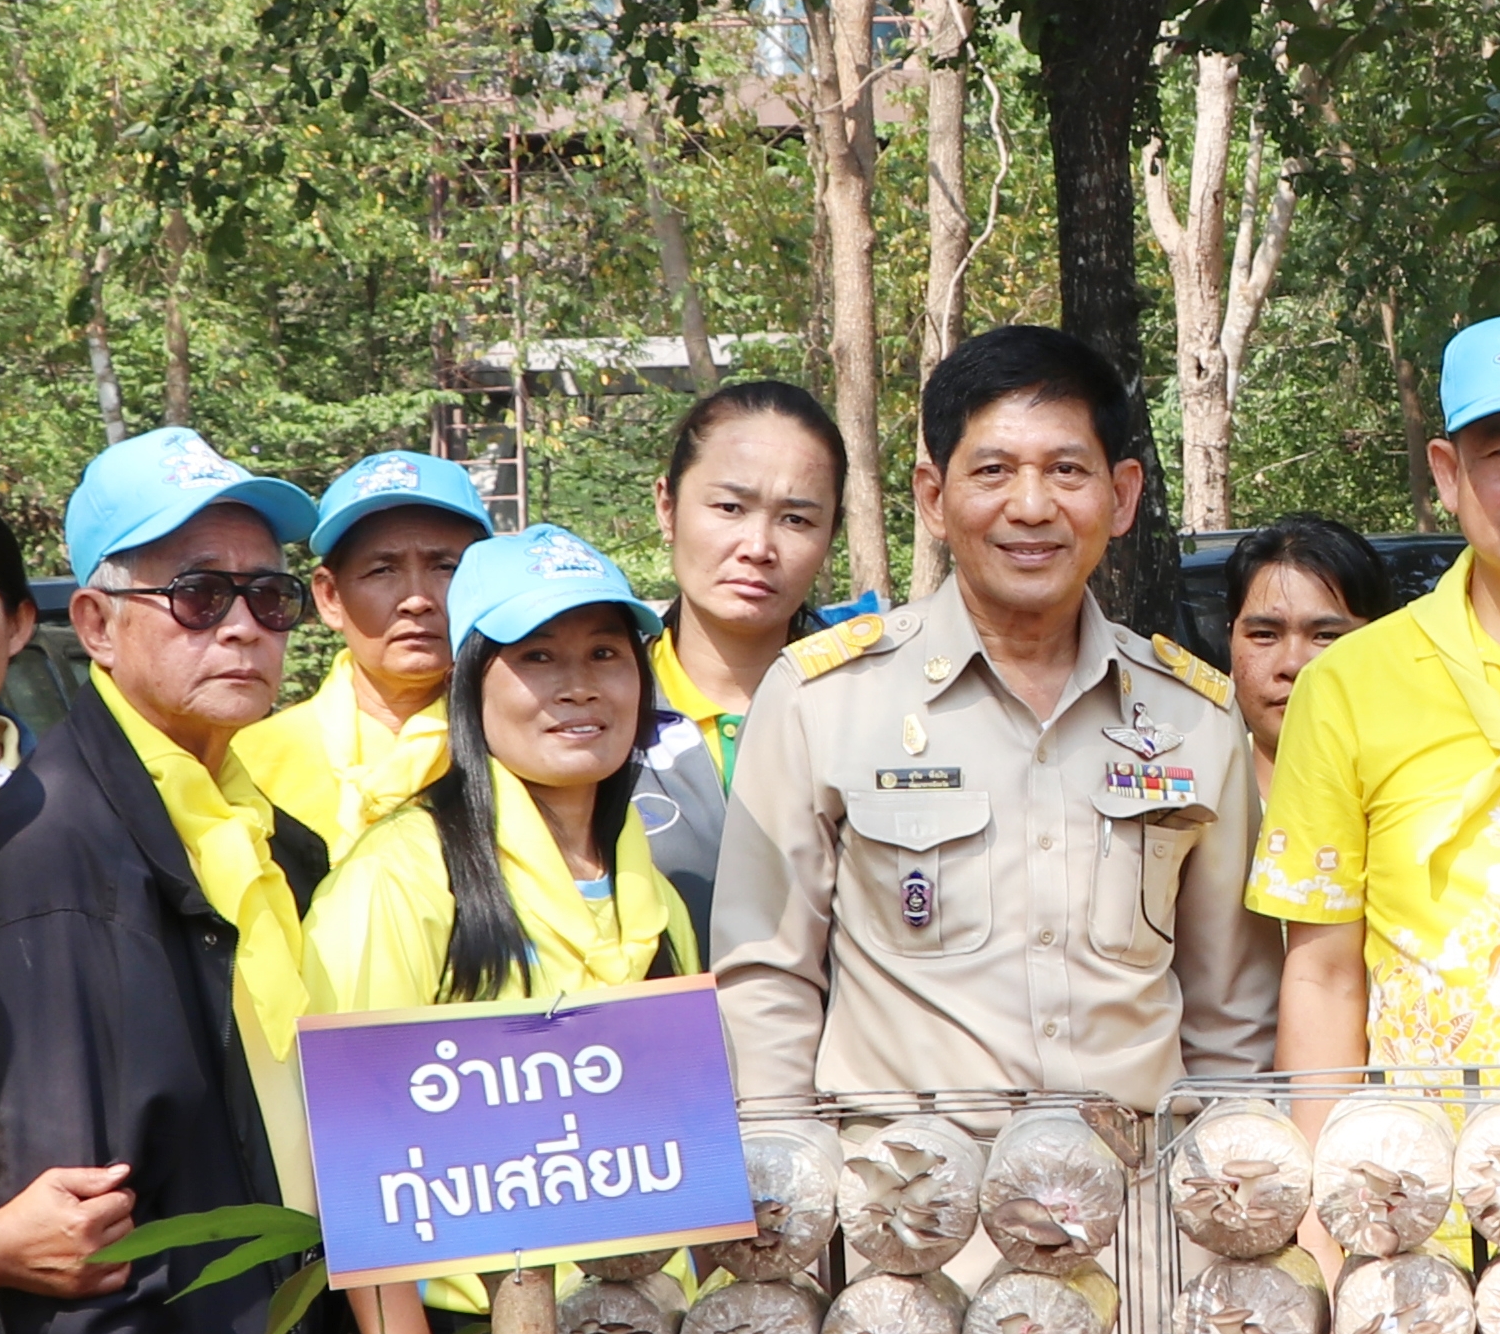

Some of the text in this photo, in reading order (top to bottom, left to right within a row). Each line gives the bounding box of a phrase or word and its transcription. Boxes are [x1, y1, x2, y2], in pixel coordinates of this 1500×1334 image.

[409, 1039, 623, 1113] อำเภอ
[379, 1112, 683, 1242] ทุ่งเสลี่ยม
